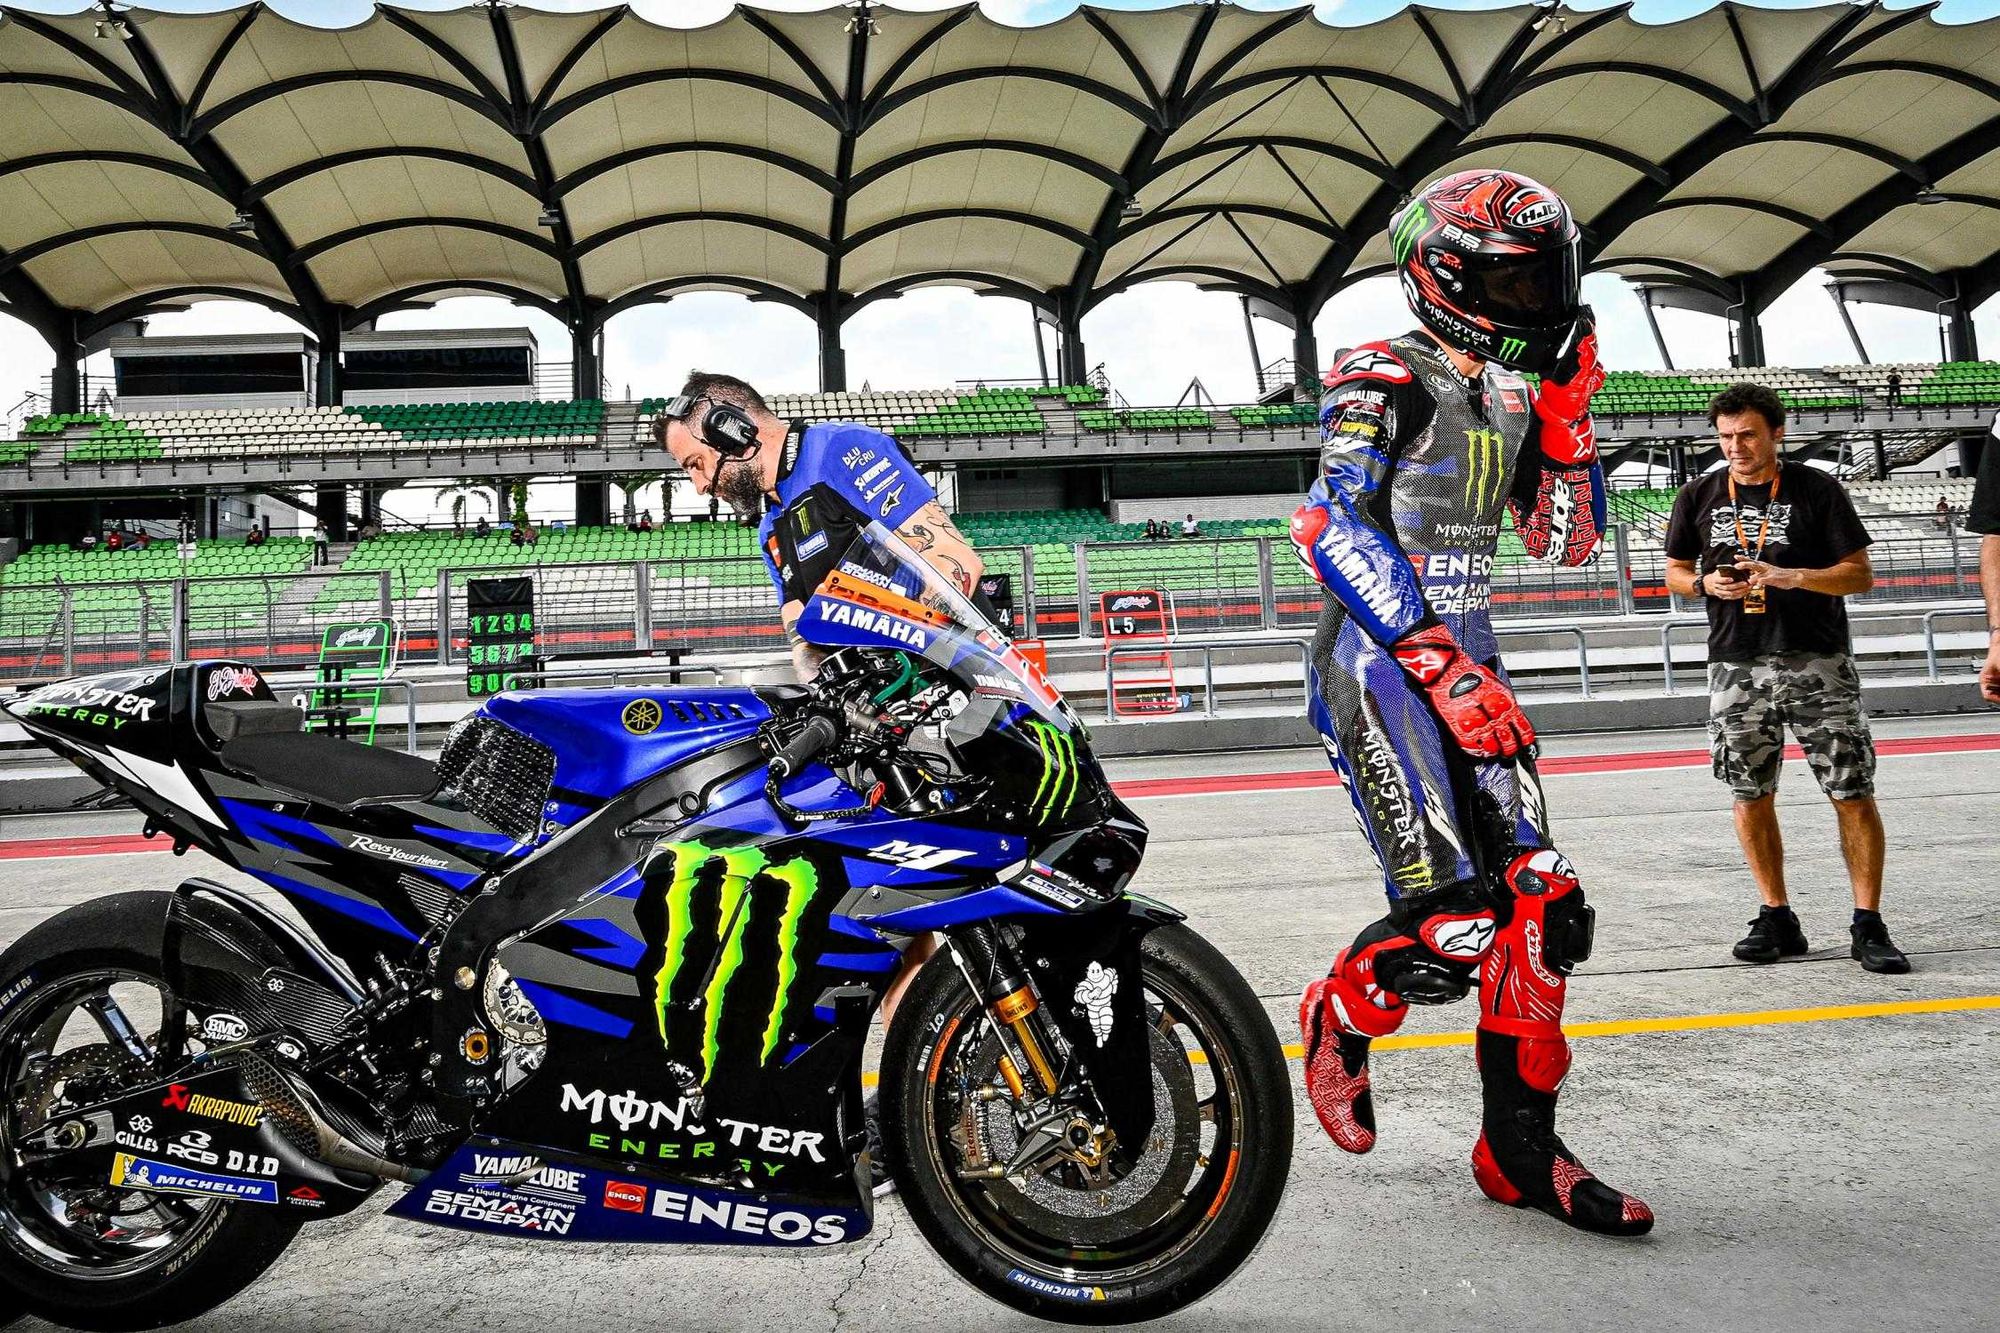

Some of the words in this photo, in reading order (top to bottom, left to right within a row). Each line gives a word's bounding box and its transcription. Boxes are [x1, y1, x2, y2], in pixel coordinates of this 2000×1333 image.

[1521, 204, 1558, 225] HJC
[1442, 219, 1482, 249] BS
[1433, 347, 1470, 388] YAMAHA
[1319, 524, 1402, 624] YAMAHA
[821, 600, 926, 649] YAMAHA
[1362, 729, 1416, 849] MONSTER
[868, 840, 978, 870] M1
[207, 1018, 243, 1037] BMC
[115, 1131, 159, 1153] GILLES
[166, 1143, 219, 1165] RCB
[226, 1150, 279, 1176] D.I.D
[155, 1174, 262, 1195] MICHELIN
[607, 1191, 642, 1203] ENEOS
[476, 1188, 501, 1197] Liquid
[502, 1192, 529, 1203] Engine
[530, 1196, 576, 1210] Component
[460, 1205, 570, 1235] DEPAN
[652, 1189, 847, 1244] ENEOS
[1014, 1273, 1080, 1297] MICHELIN
